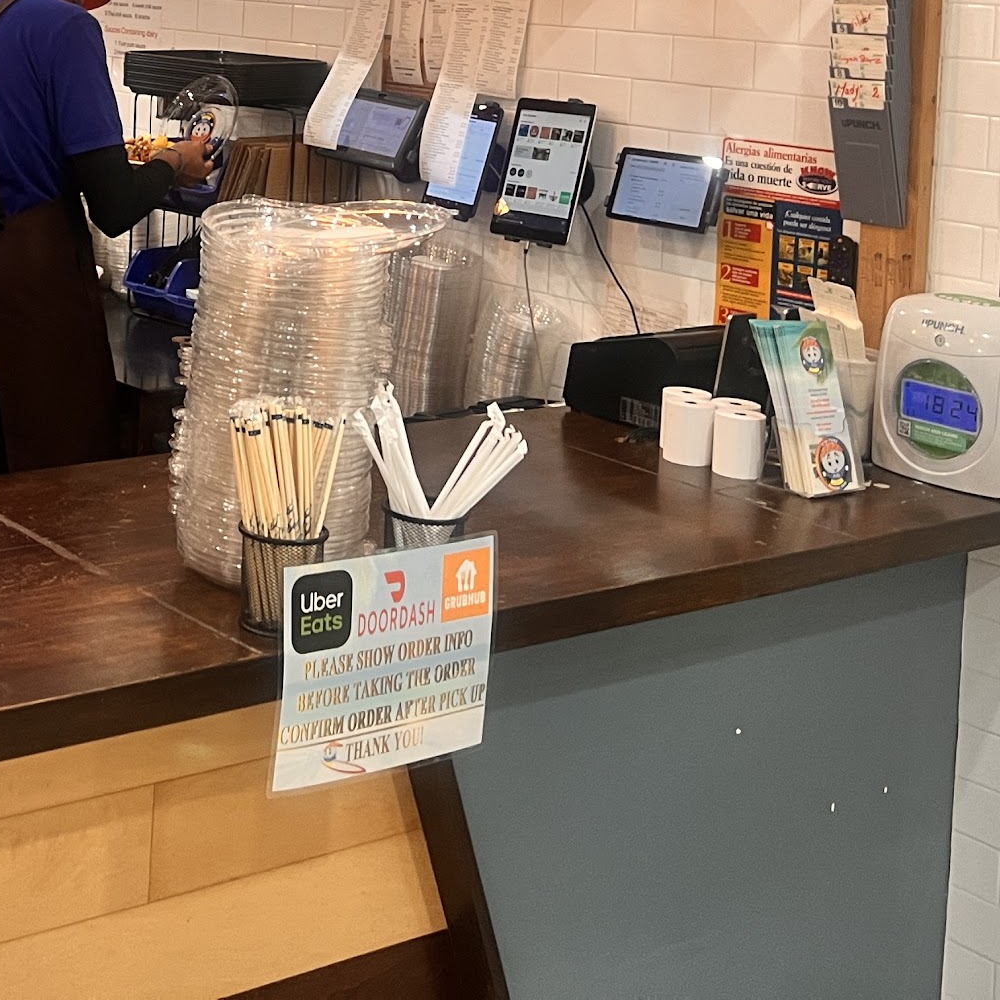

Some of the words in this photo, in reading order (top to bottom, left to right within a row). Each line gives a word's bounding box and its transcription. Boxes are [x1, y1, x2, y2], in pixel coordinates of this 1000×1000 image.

[105, 25, 120, 33] Sauces
[121, 27, 145, 37] Containing
[872, 86, 879, 98] 2
[726, 142, 760, 157] Alergias
[764, 147, 817, 164] alimentarias
[725, 156, 733, 165] Es
[751, 161, 780, 172] cuestión
[783, 164, 792, 174] de
[801, 166, 836, 180] KNOW
[748, 174, 754, 182] o
[757, 174, 791, 188] muerte
[721, 264, 731, 282] 2
[300, 592, 344, 614] Uber
[444, 590, 486, 610] GRUBHUB
[301, 613, 343, 635] Eats
[358, 600, 435, 637] DOORDASH
[304, 654, 353, 680] PLEASE
[356, 644, 395, 670] SHOW
[398, 636, 441, 662] ORDER
[444, 629, 473, 649] INFO
[297, 685, 350, 712] BEFORE
[353, 671, 403, 698] TAKING
[405, 665, 431, 690] THE
[435, 657, 476, 683] ORDER
[280, 716, 344, 745] CONFIRM
[348, 705, 392, 732] ORDER
[395, 695, 436, 721] AFTER
[439, 690, 467, 711] PICK
[471, 683, 486, 703] UP
[345, 733, 391, 762] THANK
[394, 726, 424, 752] YOU!
